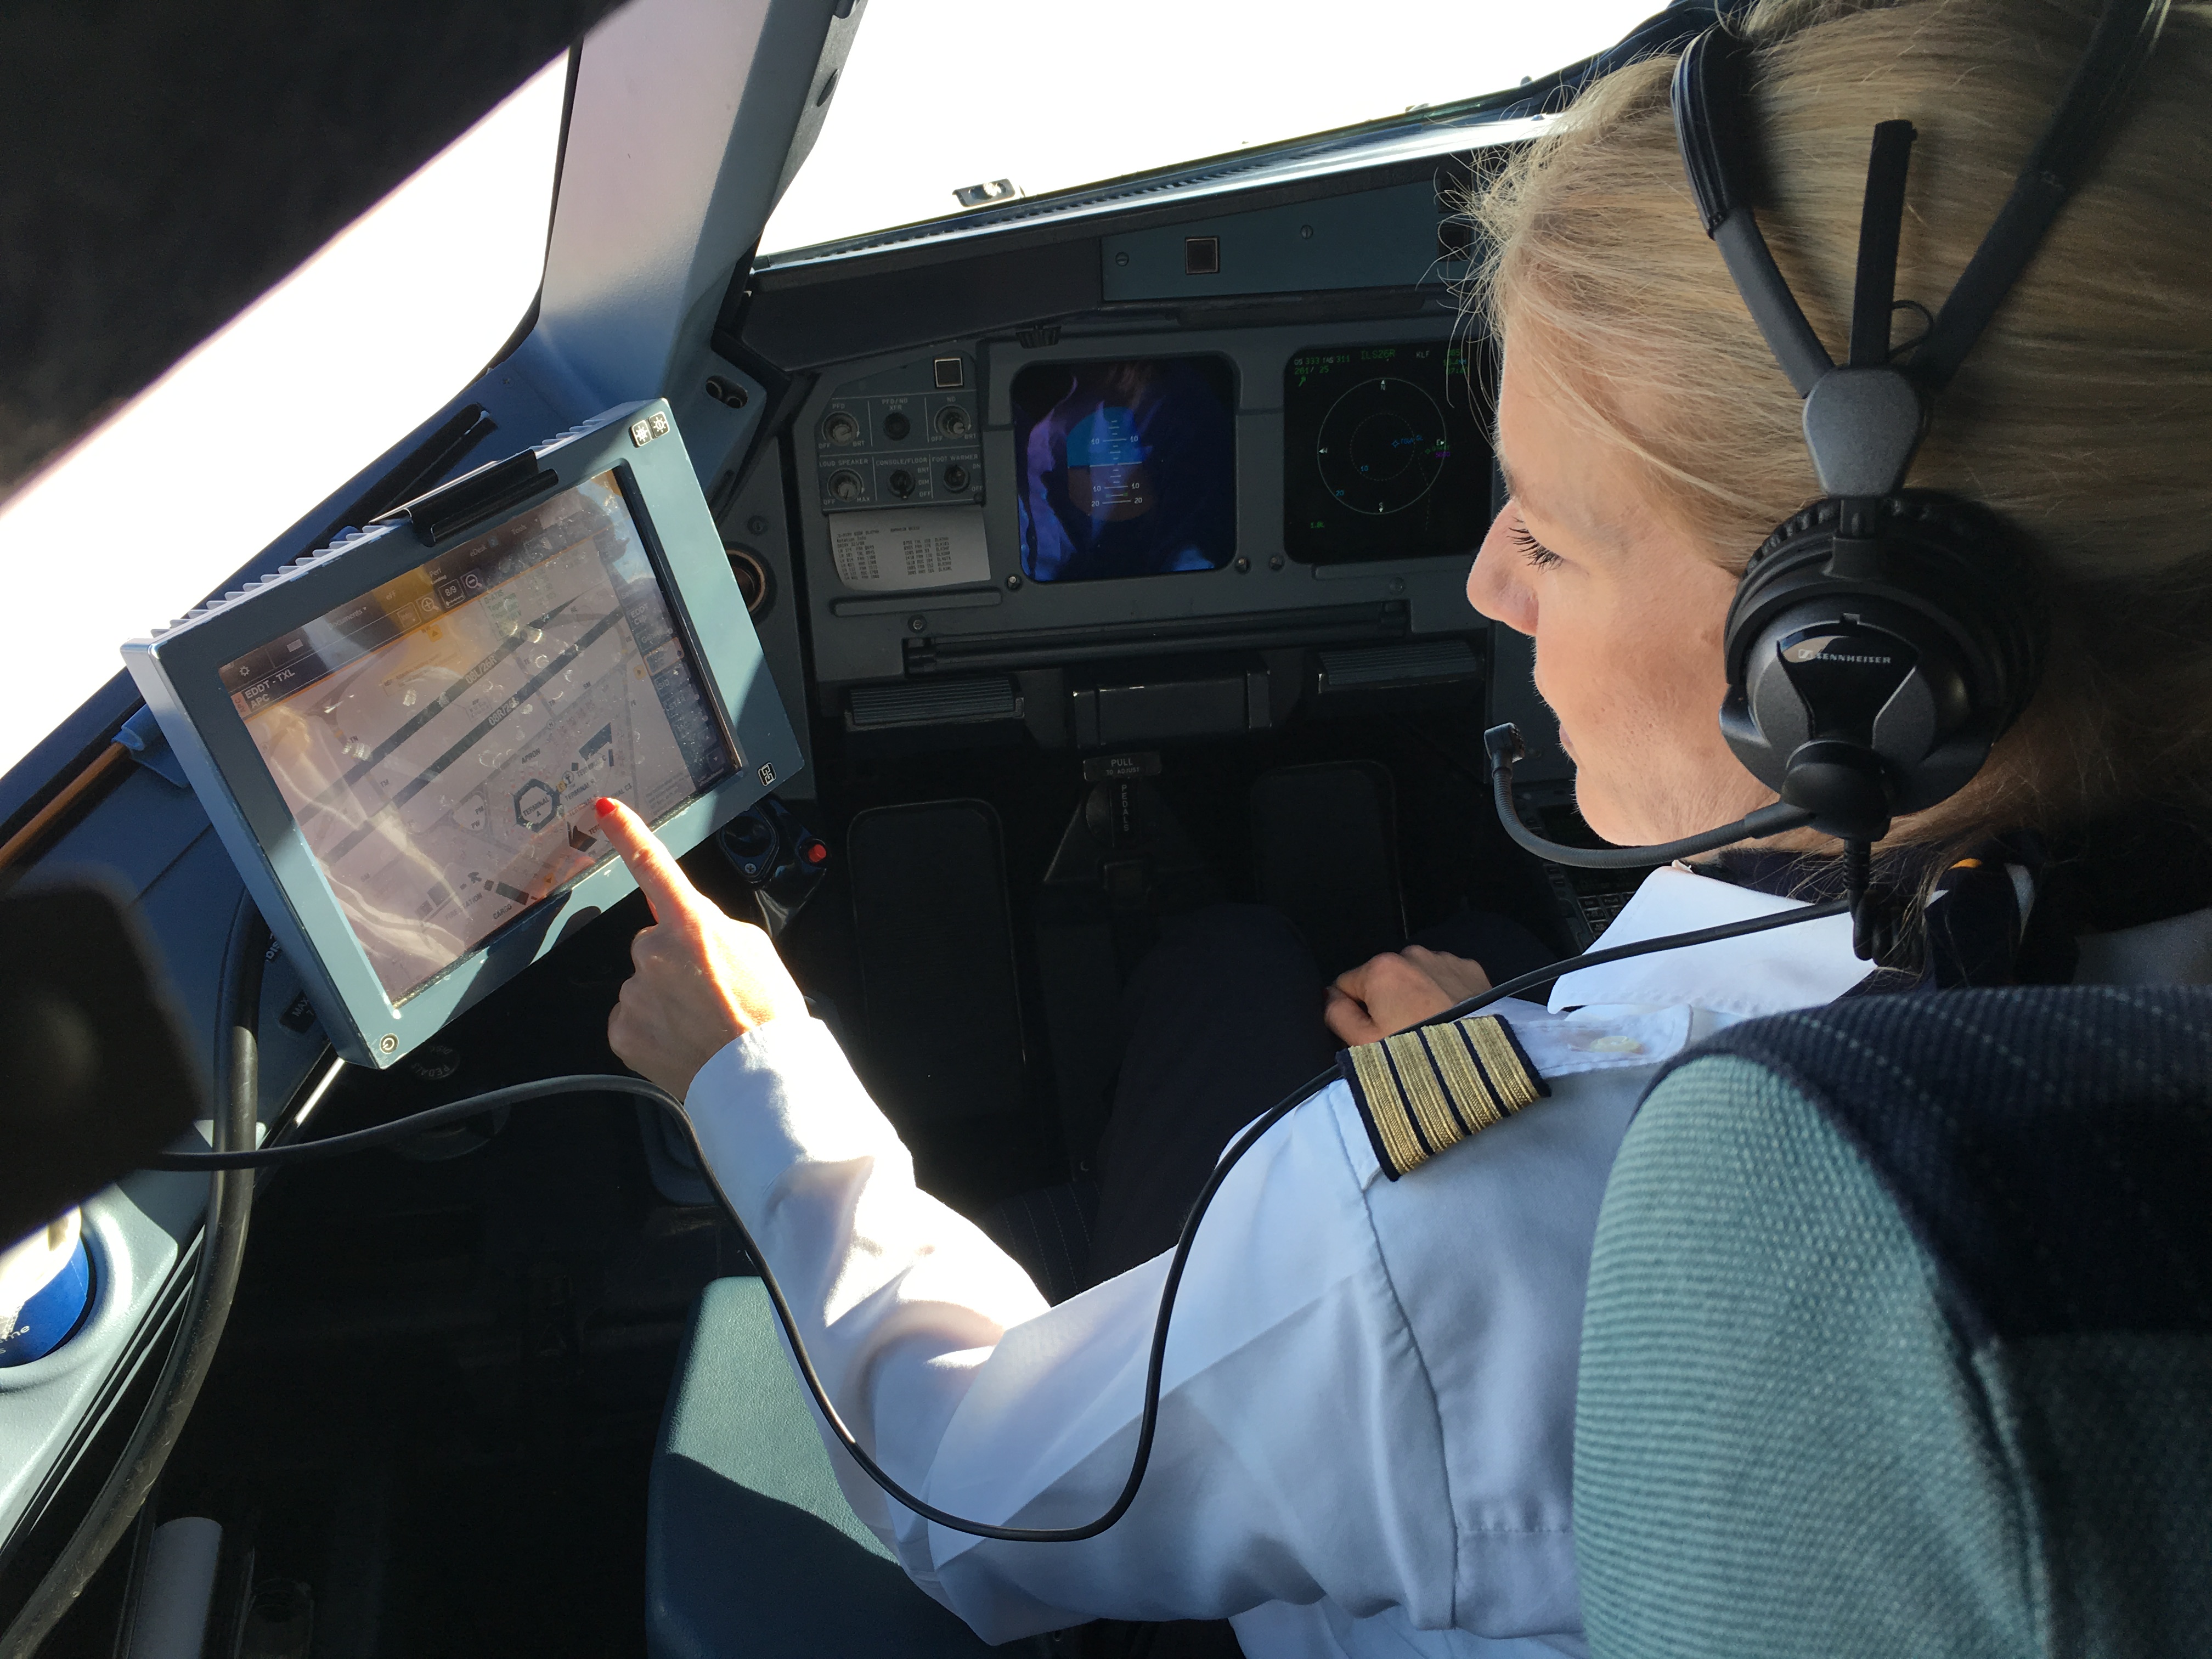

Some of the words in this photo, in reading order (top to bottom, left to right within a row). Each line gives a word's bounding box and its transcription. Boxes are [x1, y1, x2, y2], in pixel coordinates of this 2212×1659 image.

[1336, 354, 1350, 363] 311
[1361, 349, 1396, 360] ILS26R
[876, 456, 928, 466] CONSOLE/FLOOR
[951, 453, 978, 461] WARMER
[511, 524, 527, 536] Tools
[444, 585, 457, 597] 8/9
[630, 603, 648, 618] EDDT
[328, 608, 363, 631] Documents
[1815, 652, 1892, 664] SENNHEISER
[465, 654, 498, 685] 08L/26R
[244, 678, 272, 699] EDDT
[275, 668, 296, 682] TXL
[250, 693, 270, 710] APC
[521, 747, 541, 765] APRON
[1111, 758, 1133, 767] PULL
[1117, 766, 1141, 775] ADJUST
[565, 782, 591, 802] TERMINAL
[522, 796, 550, 817] TERMINAL
[1121, 783, 1130, 832] PEDALS
[445, 909, 459, 921] FIRE
[492, 904, 513, 920] CARGO
